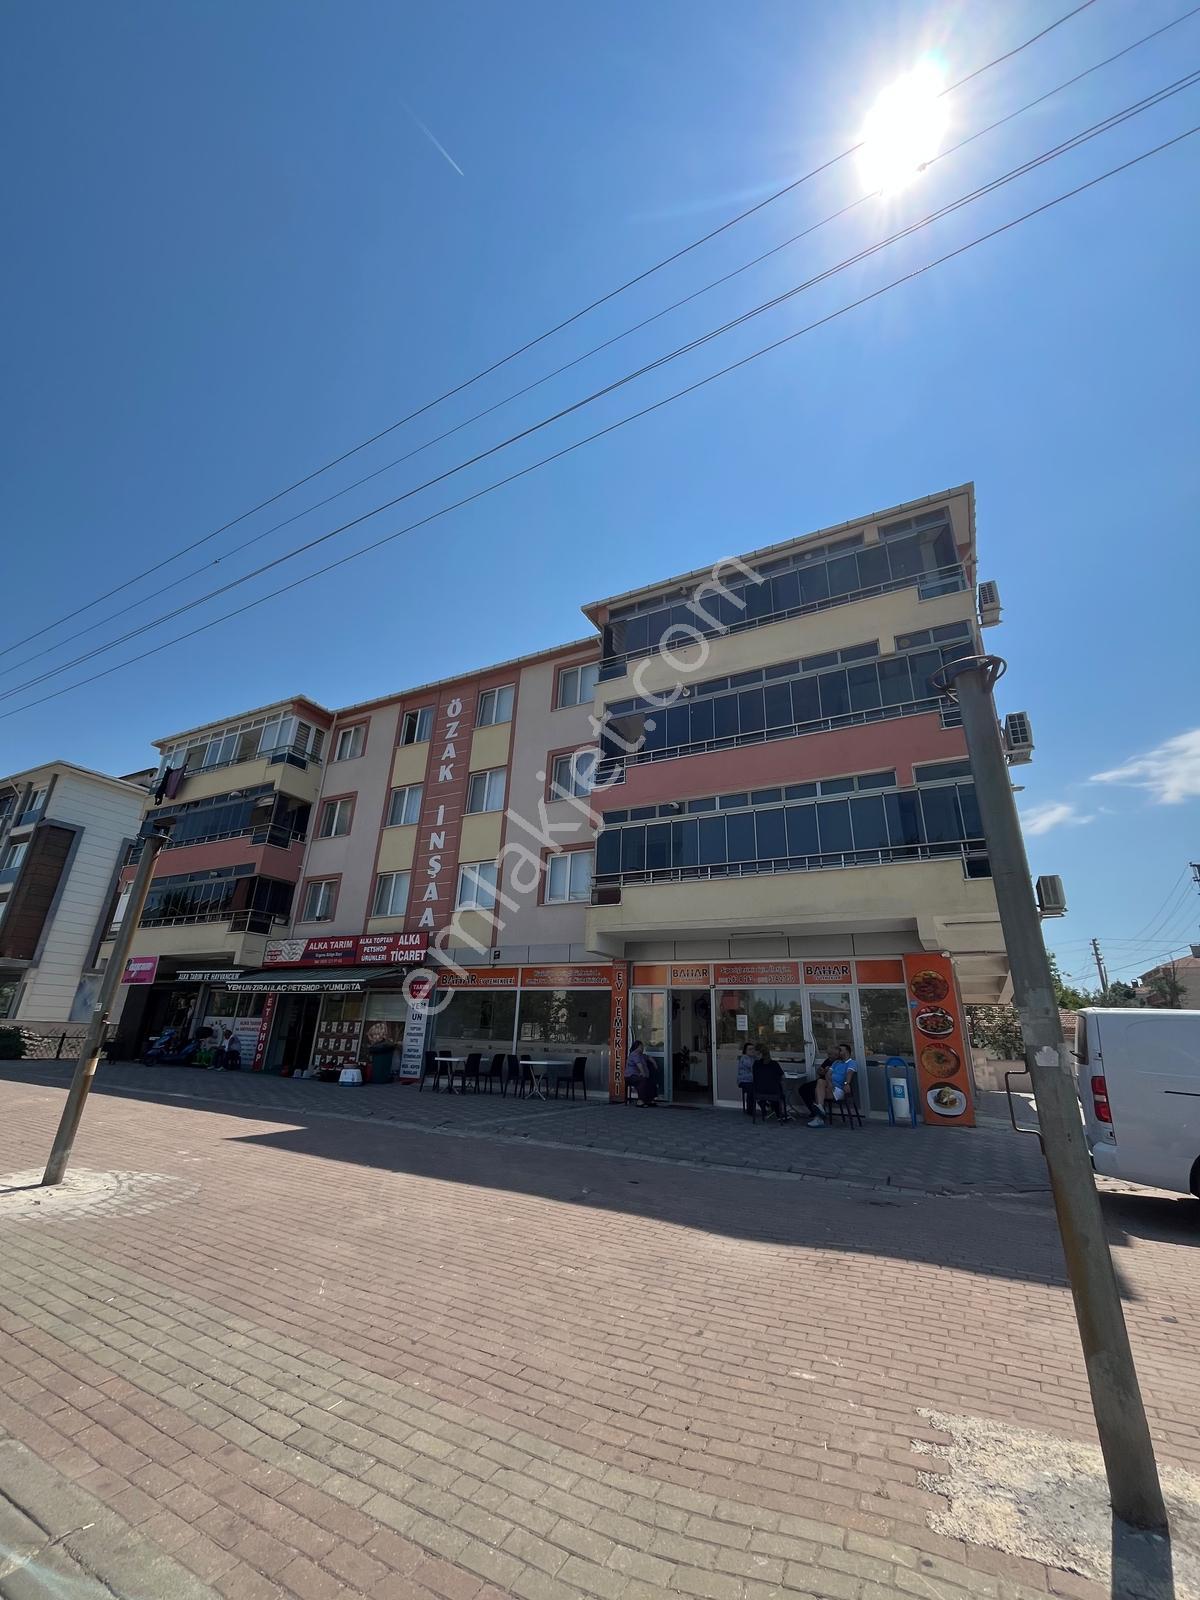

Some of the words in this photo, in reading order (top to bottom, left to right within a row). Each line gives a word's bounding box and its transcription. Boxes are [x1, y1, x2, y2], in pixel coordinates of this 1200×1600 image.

[438, 698, 462, 782] ÖZAK
[308, 942, 328, 951] ALKA
[330, 940, 353, 950] TARIM
[373, 936, 394, 944] TOPTAN
[398, 934, 420, 946] ALKA
[363, 945, 387, 953] PETSHOP
[390, 948, 426, 962] TİCARET
[672, 967, 708, 978] BAHAR
[805, 964, 850, 976] BAHAR
[615, 971, 623, 991] EV
[411, 1013, 423, 1021] UN
[255, 1022, 269, 1062] SHOP
